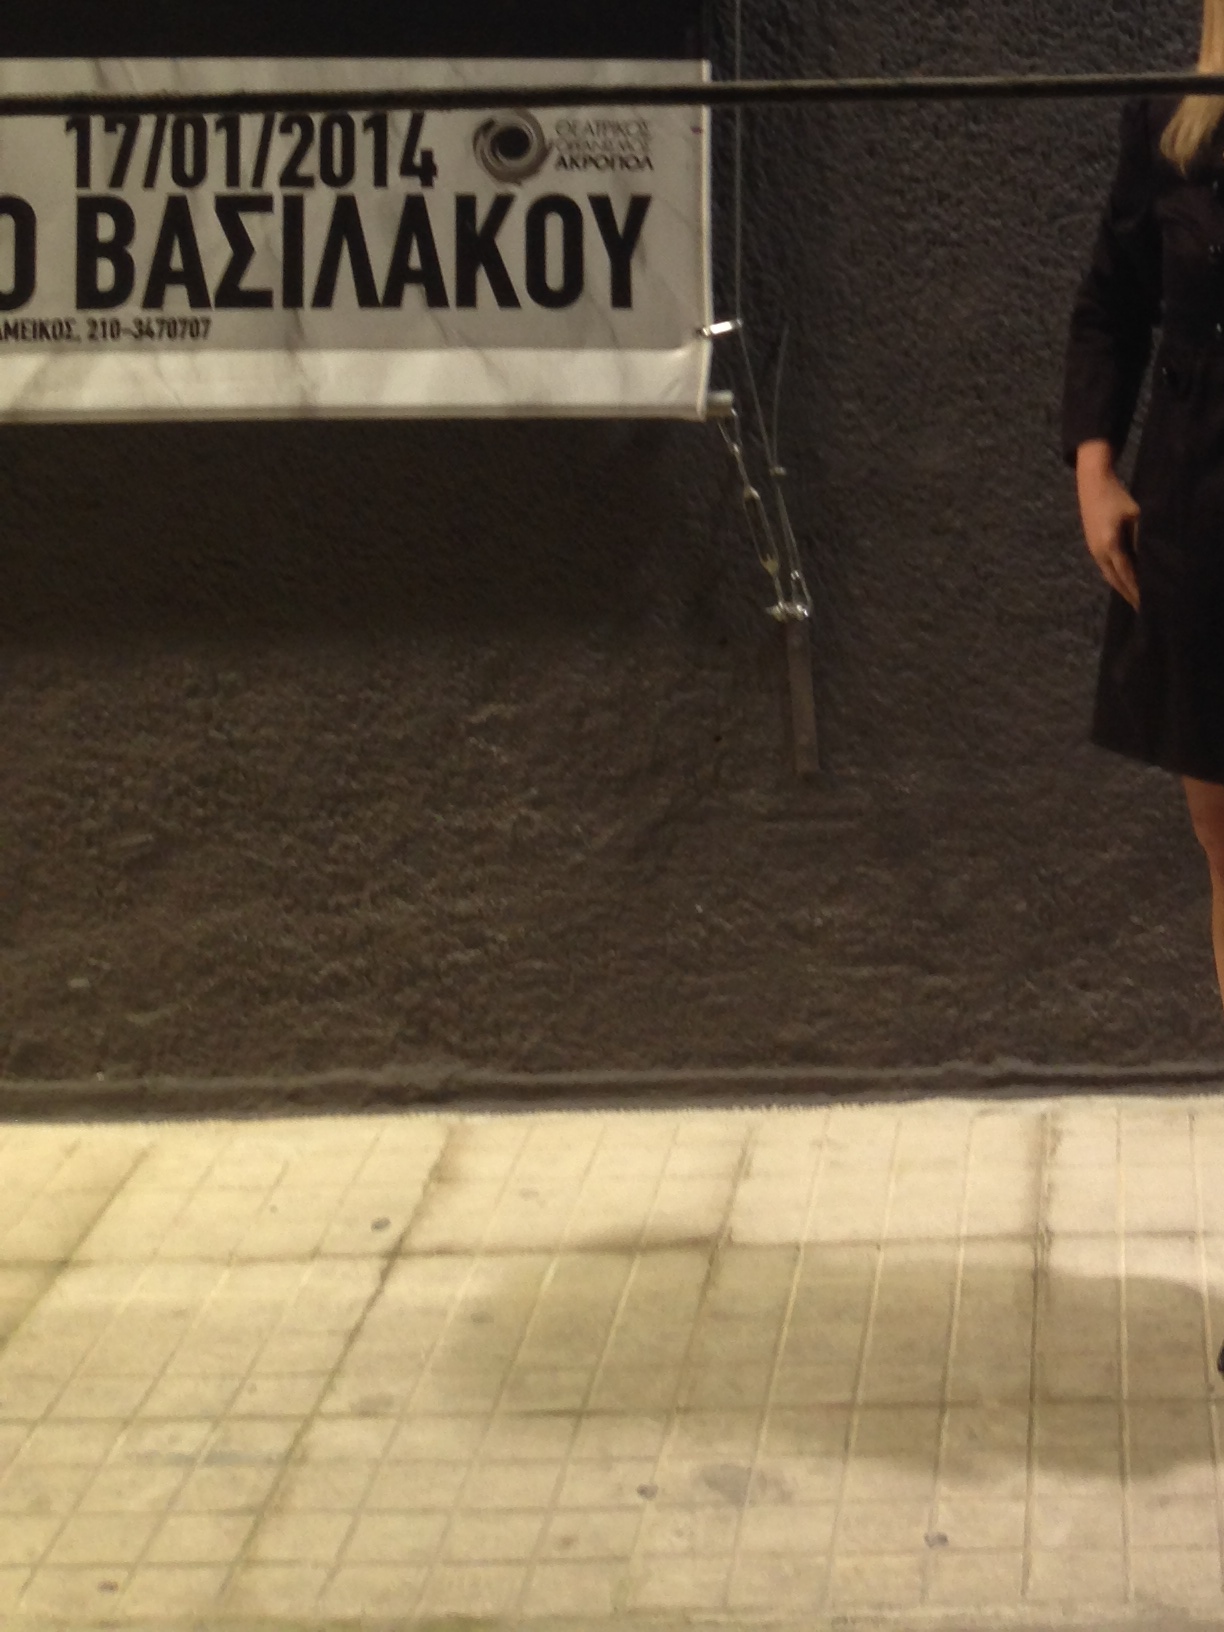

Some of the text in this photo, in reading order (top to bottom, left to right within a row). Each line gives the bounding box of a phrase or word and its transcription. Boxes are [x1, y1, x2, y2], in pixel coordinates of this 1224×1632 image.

[65, 112, 437, 189] 17/01/2014
[75, 193, 653, 310] ΒΑΣΙΛΑΚΟΥ
[0, 317, 212, 342] ΜΕΙΚΟΣ, 210-3470707
